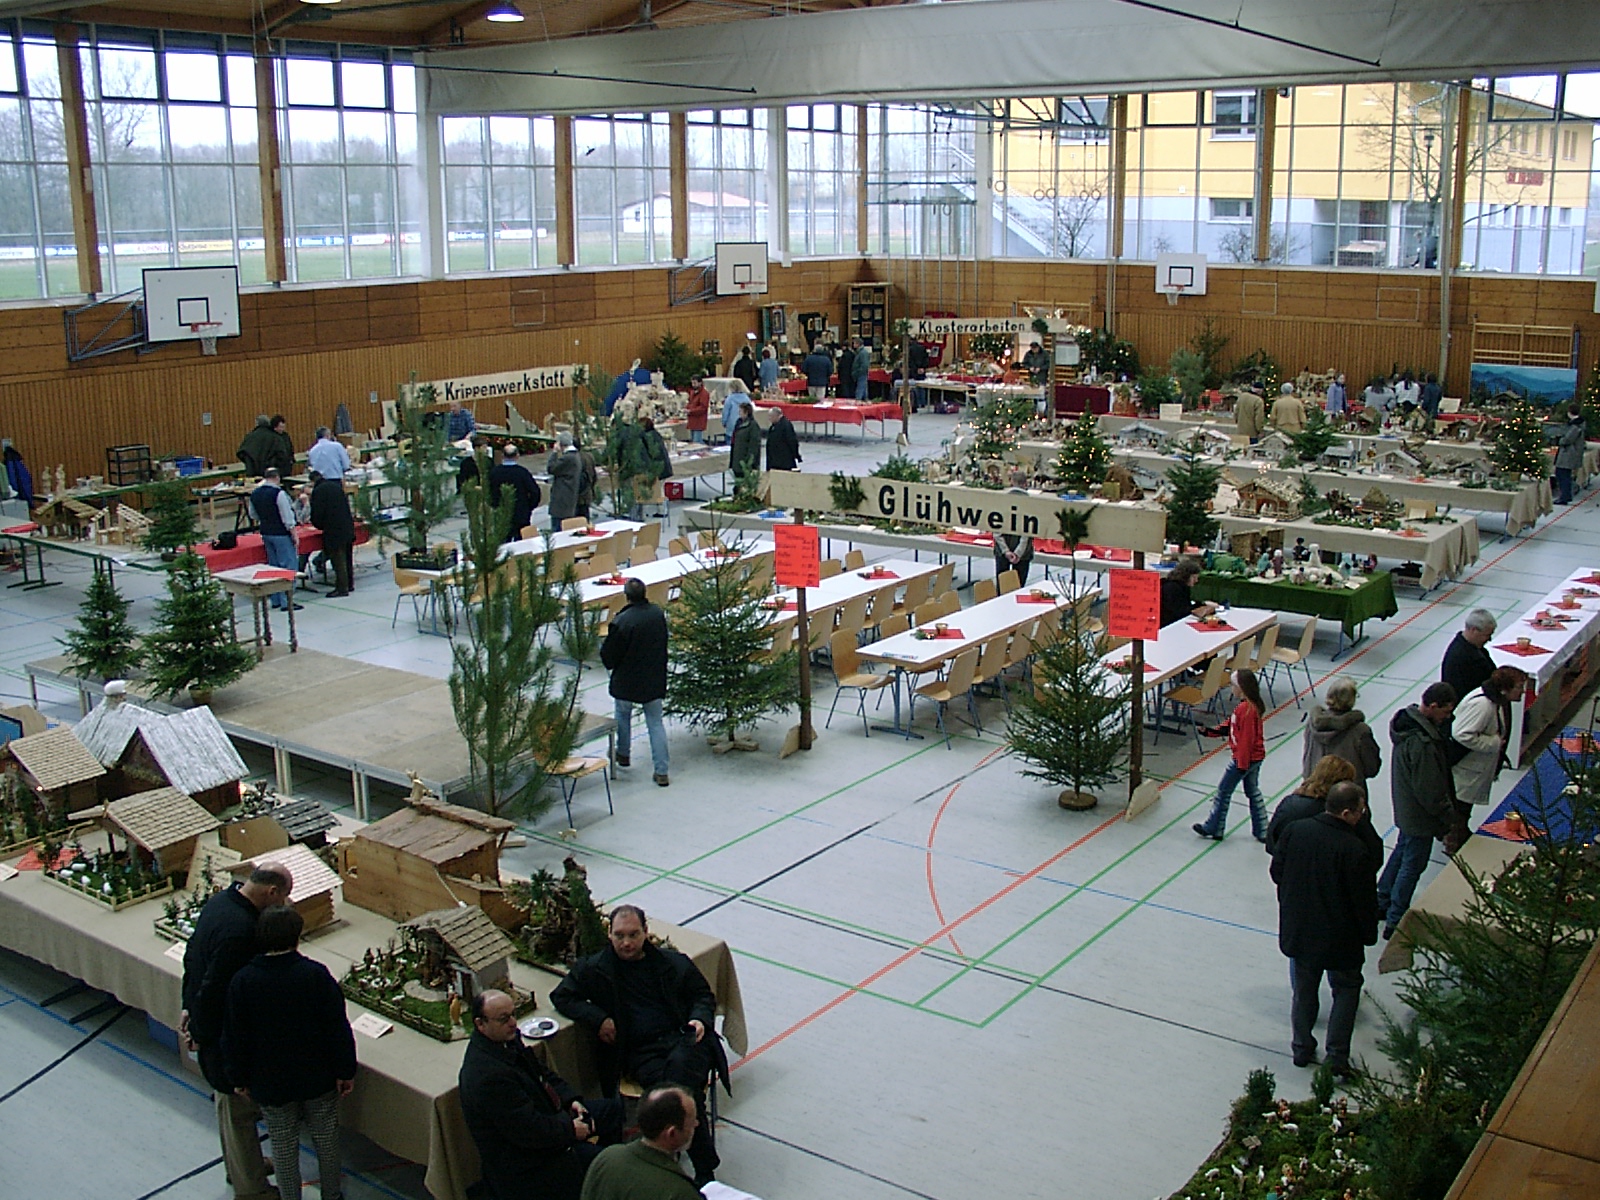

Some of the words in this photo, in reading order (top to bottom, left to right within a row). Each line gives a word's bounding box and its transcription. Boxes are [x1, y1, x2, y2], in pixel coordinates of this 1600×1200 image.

[919, 320, 1025, 334] Klosterarbeiten
[445, 370, 565, 400] Krippenwerkstatt
[878, 485, 1039, 534] Glühwein
